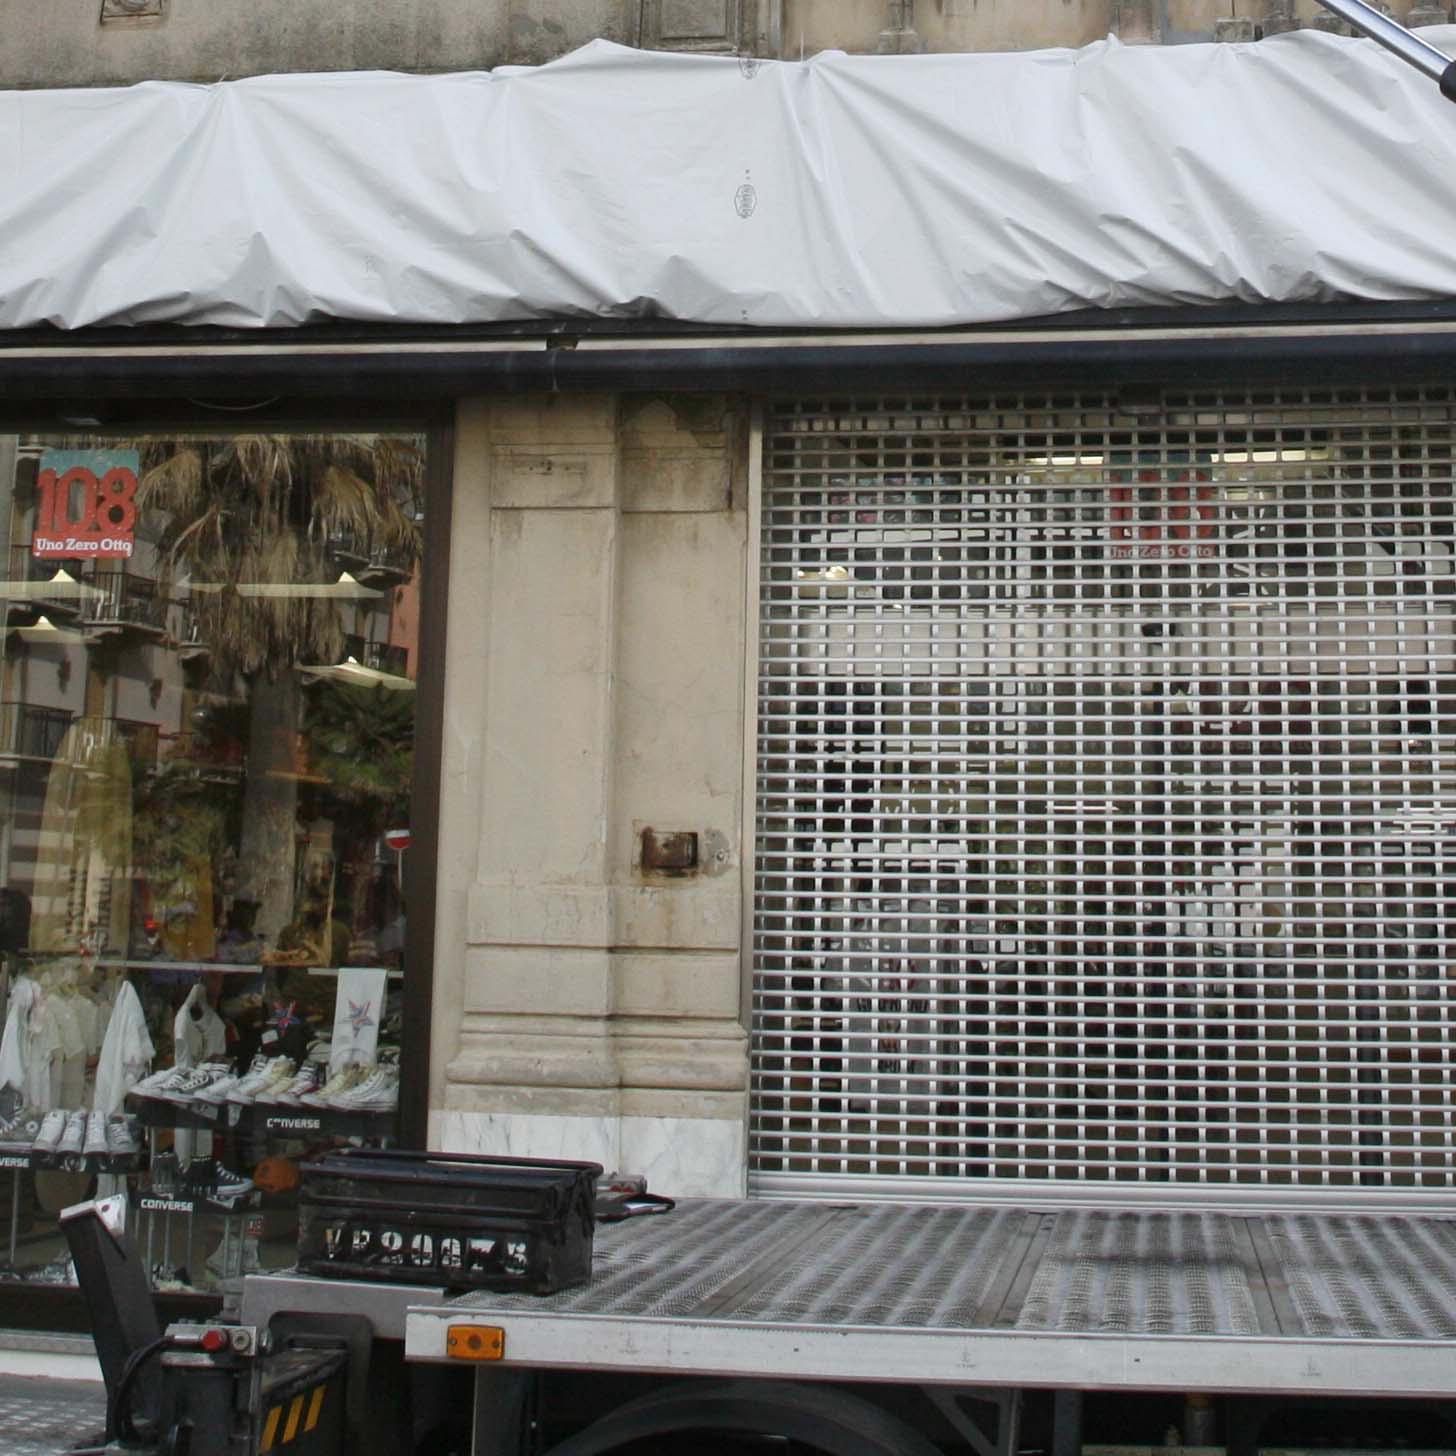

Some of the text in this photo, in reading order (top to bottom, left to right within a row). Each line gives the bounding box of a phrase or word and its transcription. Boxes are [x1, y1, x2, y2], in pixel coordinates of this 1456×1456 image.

[37, 466, 139, 532] 108
[36, 537, 133, 551] Uno Zero Otto
[1138, 544, 1176, 558] Zeo
[1177, 544, 1213, 558] Oto
[140, 1198, 194, 1212] CONVERSE
